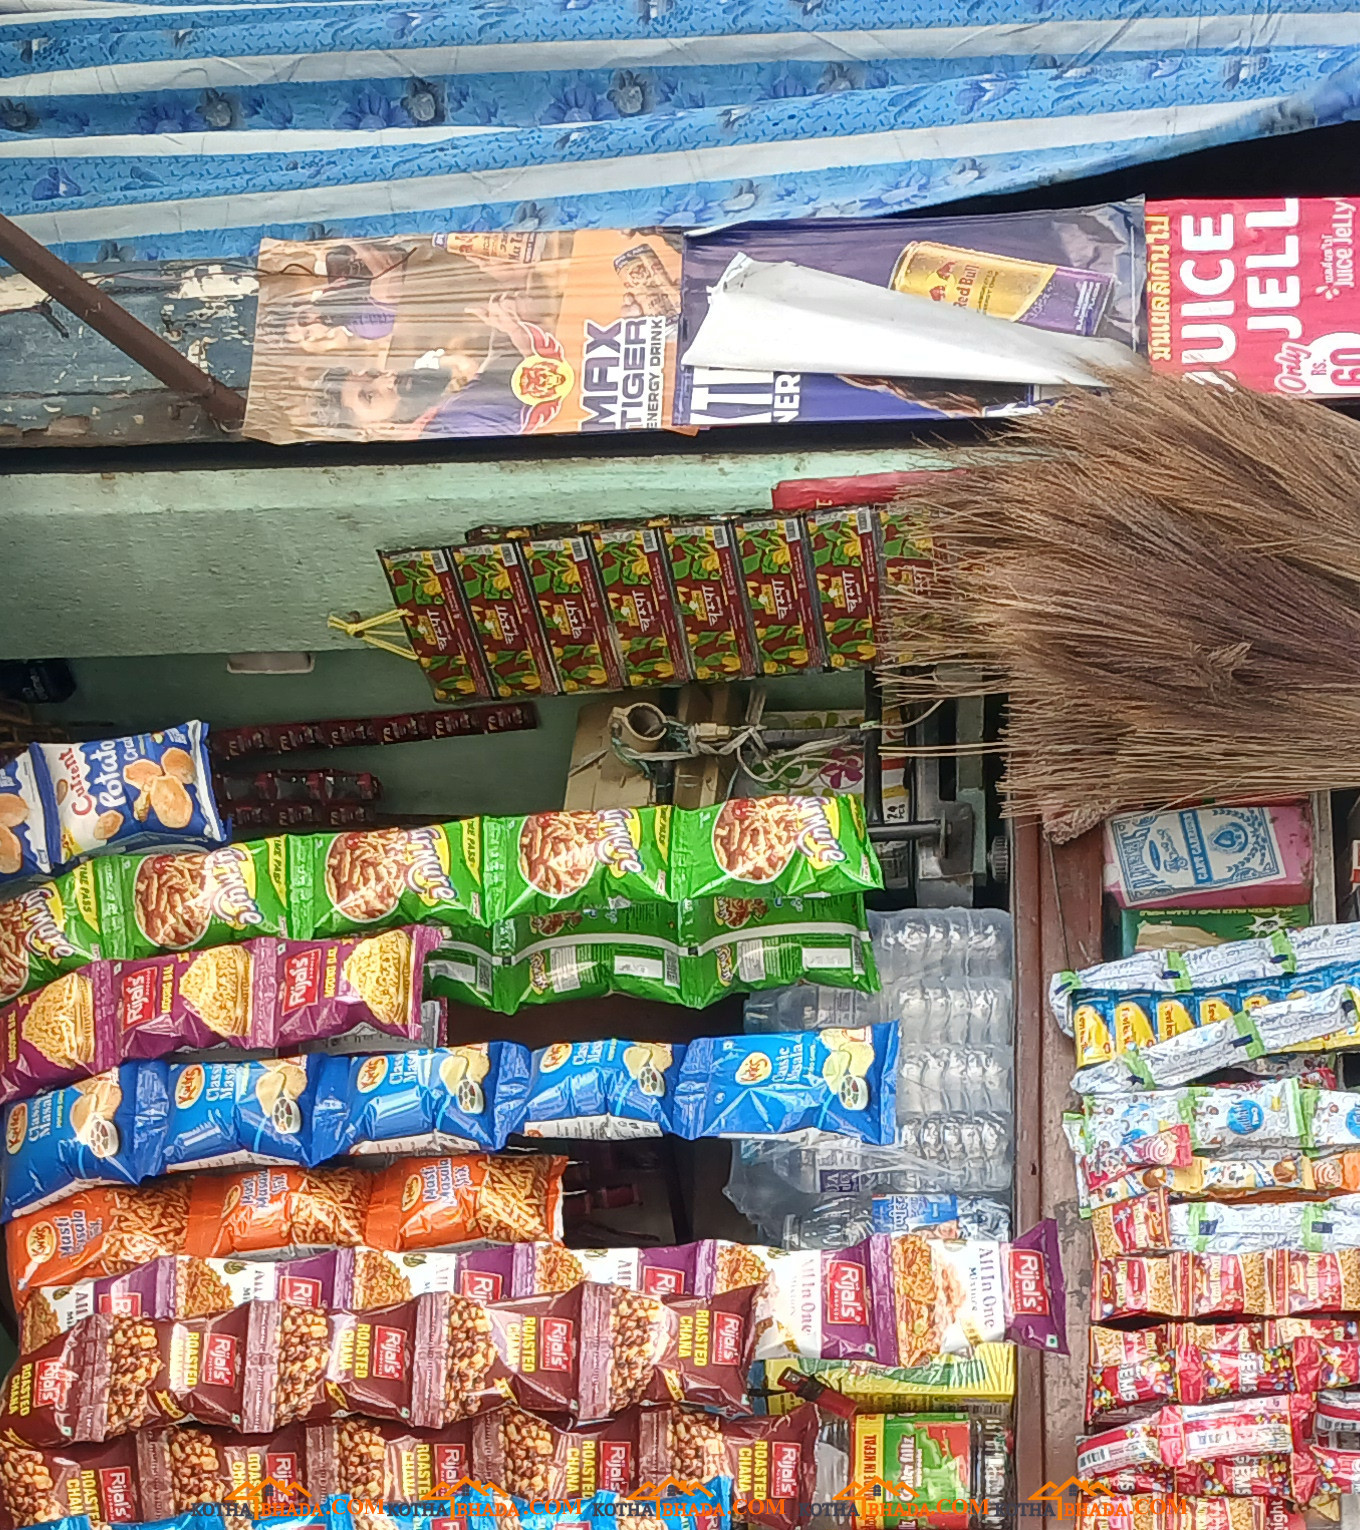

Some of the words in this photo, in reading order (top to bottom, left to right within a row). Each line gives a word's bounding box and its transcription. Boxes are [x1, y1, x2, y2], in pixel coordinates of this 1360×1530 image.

[958, 264, 980, 285] Bull
[649, 318, 664, 368] DRINK
[1274, 342, 1313, 392] Only
[582, 319, 623, 429] MAX
[621, 318, 648, 429] TIGER
[646, 370, 662, 429] ENERGY
[57, 748, 92, 815] Current
[90, 740, 127, 808] Potato
[126, 976, 152, 1022] Rijal's
[289, 956, 312, 1005] Rijal's
[422, 1167, 438, 1200] Masti
[439, 1158, 456, 1205] Masala
[838, 1266, 861, 1318] Rijal's
[1022, 1255, 1043, 1307] Rijal's
[678, 1316, 692, 1357] CHANA
[694, 1310, 710, 1366] ROASTED
[982, 1298, 996, 1327] One
[186, 1331, 200, 1385] ROASTED
[355, 1323, 370, 1378] ROASTED
[522, 1317, 537, 1372] ROASTED
[8, 1375, 20, 1415] CHANA
[19, 1363, 34, 1416] ROASTED
[567, 1447, 579, 1492] CHANA
[582, 1441, 596, 1499] ROASTED
[739, 1447, 753, 1492] CHANA
[755, 1440, 769, 1500] ROASTED
[863, 1435, 877, 1462] NEPAL
[863, 1465, 877, 1473] IN
